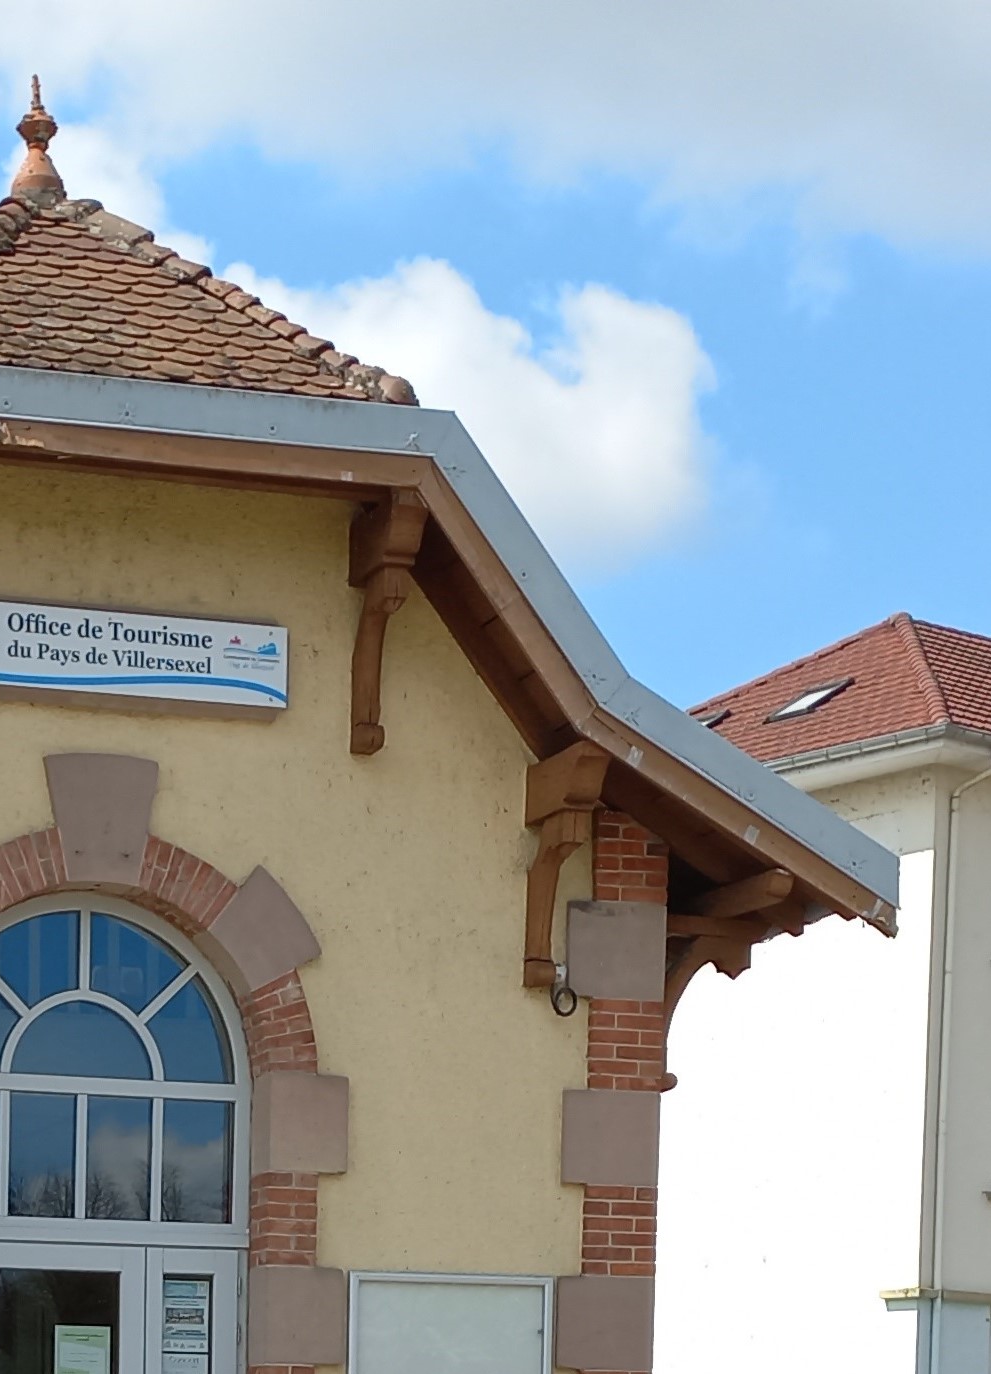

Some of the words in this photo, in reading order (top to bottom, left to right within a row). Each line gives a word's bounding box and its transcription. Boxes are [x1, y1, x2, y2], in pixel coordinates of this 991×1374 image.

[8, 612, 71, 636] Office
[77, 617, 103, 639] de
[108, 621, 213, 649] Tourisme
[7, 639, 32, 658] du
[37, 643, 81, 666] Pays
[85, 646, 108, 665] de
[112, 649, 212, 674] Villersexel
